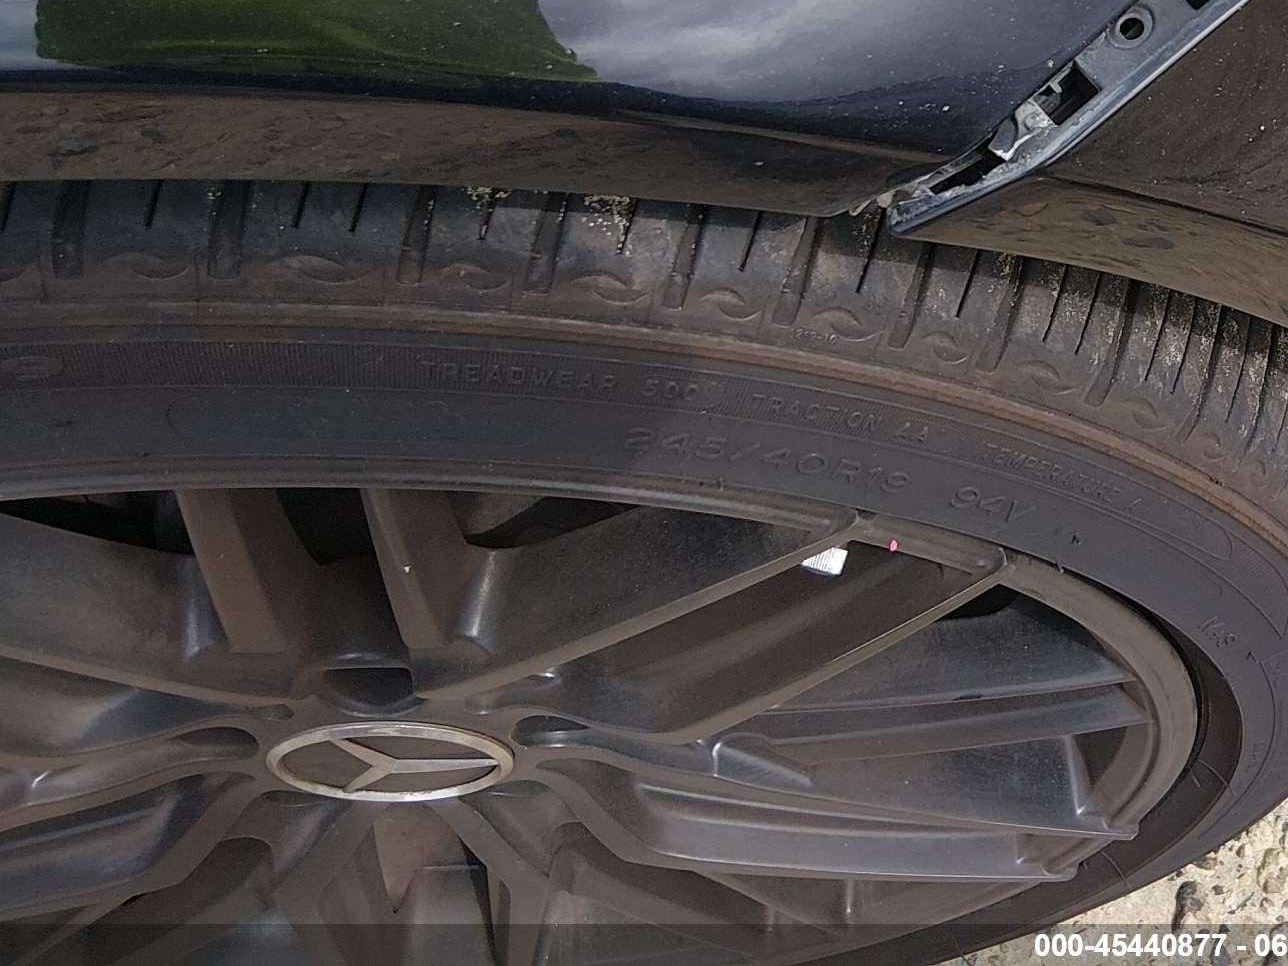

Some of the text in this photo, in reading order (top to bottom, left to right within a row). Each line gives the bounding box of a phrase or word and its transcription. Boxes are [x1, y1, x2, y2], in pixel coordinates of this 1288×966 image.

[418, 360, 617, 392] TREADWEAR
[751, 392, 884, 433] TRACTION
[623, 425, 912, 495] 245/40R19
[983, 441, 1122, 505] TEMPERATURE
